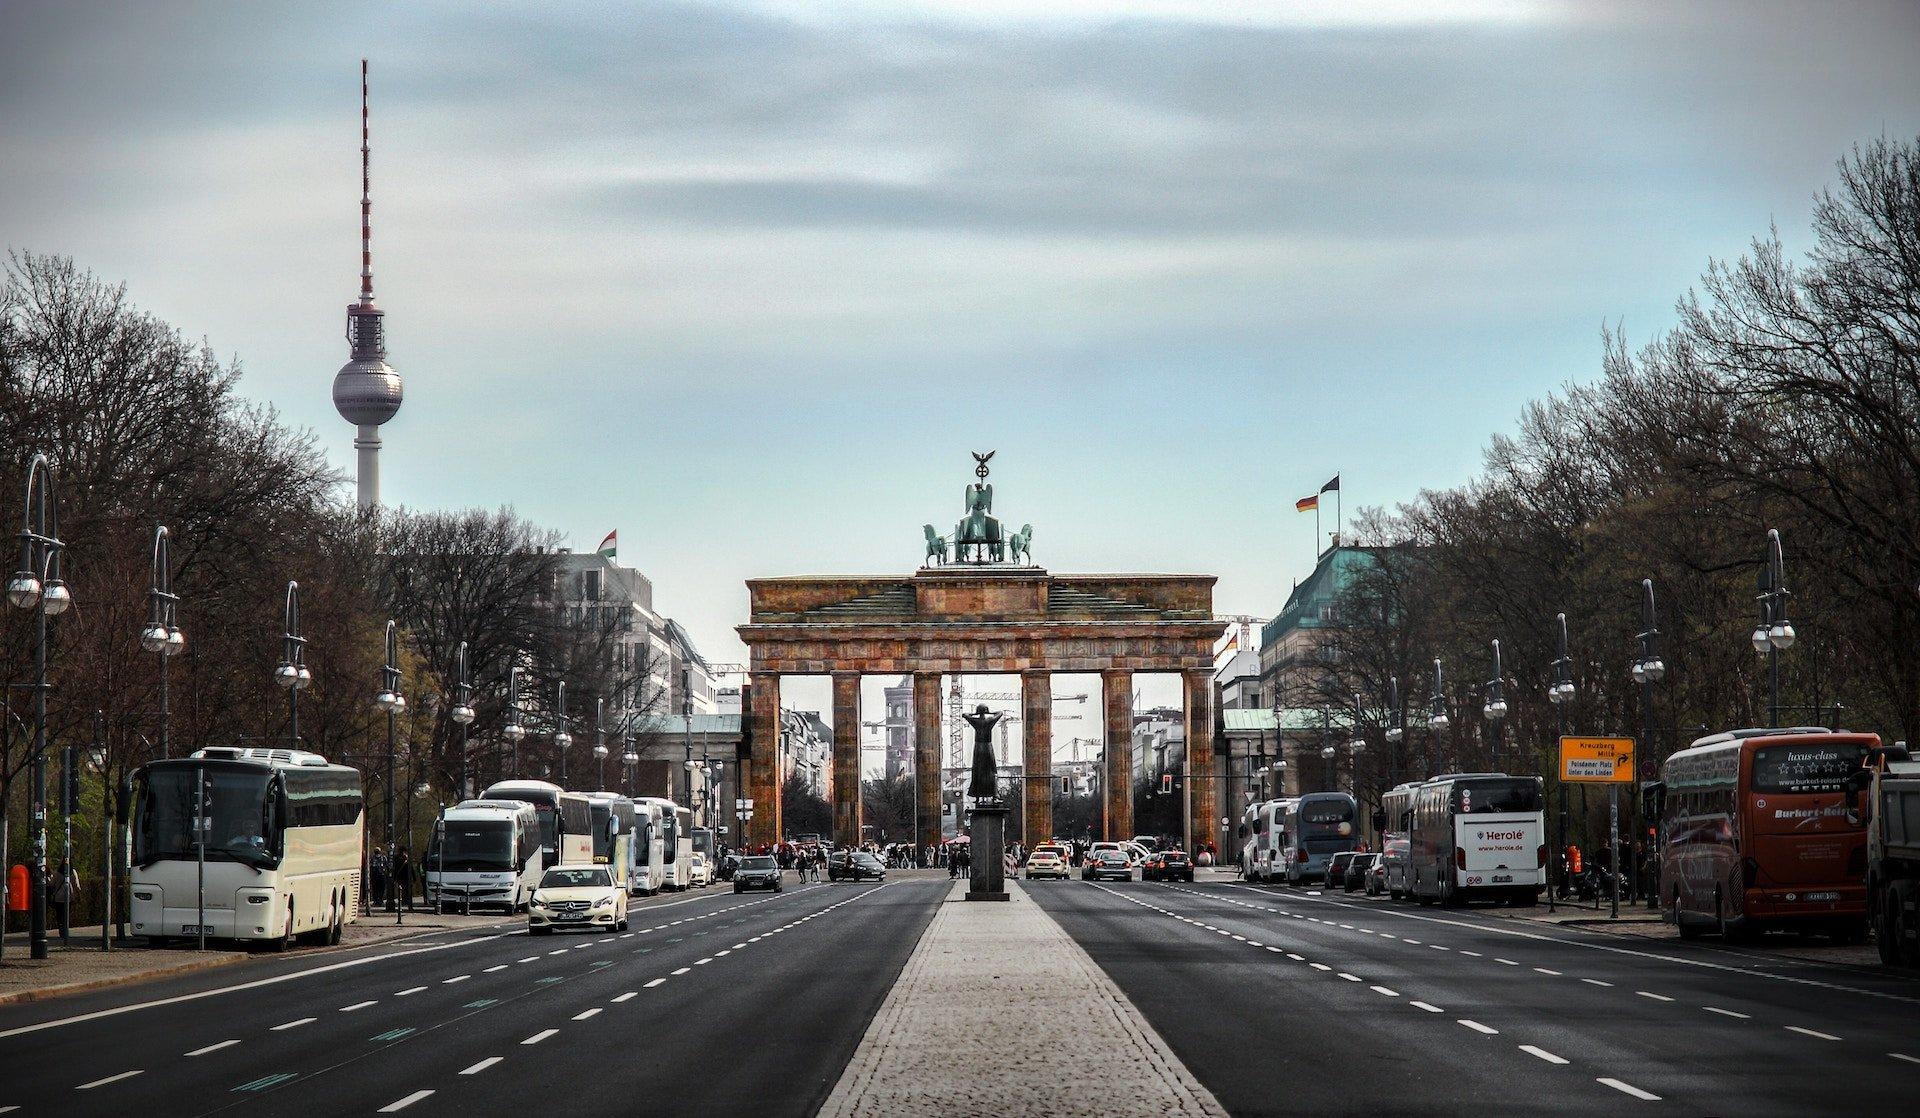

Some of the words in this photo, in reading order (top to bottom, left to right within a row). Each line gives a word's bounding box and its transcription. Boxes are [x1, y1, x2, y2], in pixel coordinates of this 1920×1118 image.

[1580, 742, 1615, 750] Kreuzberg
[1787, 750, 1838, 761] luxus-class
[1775, 807, 1846, 819] Burkert-Reis
